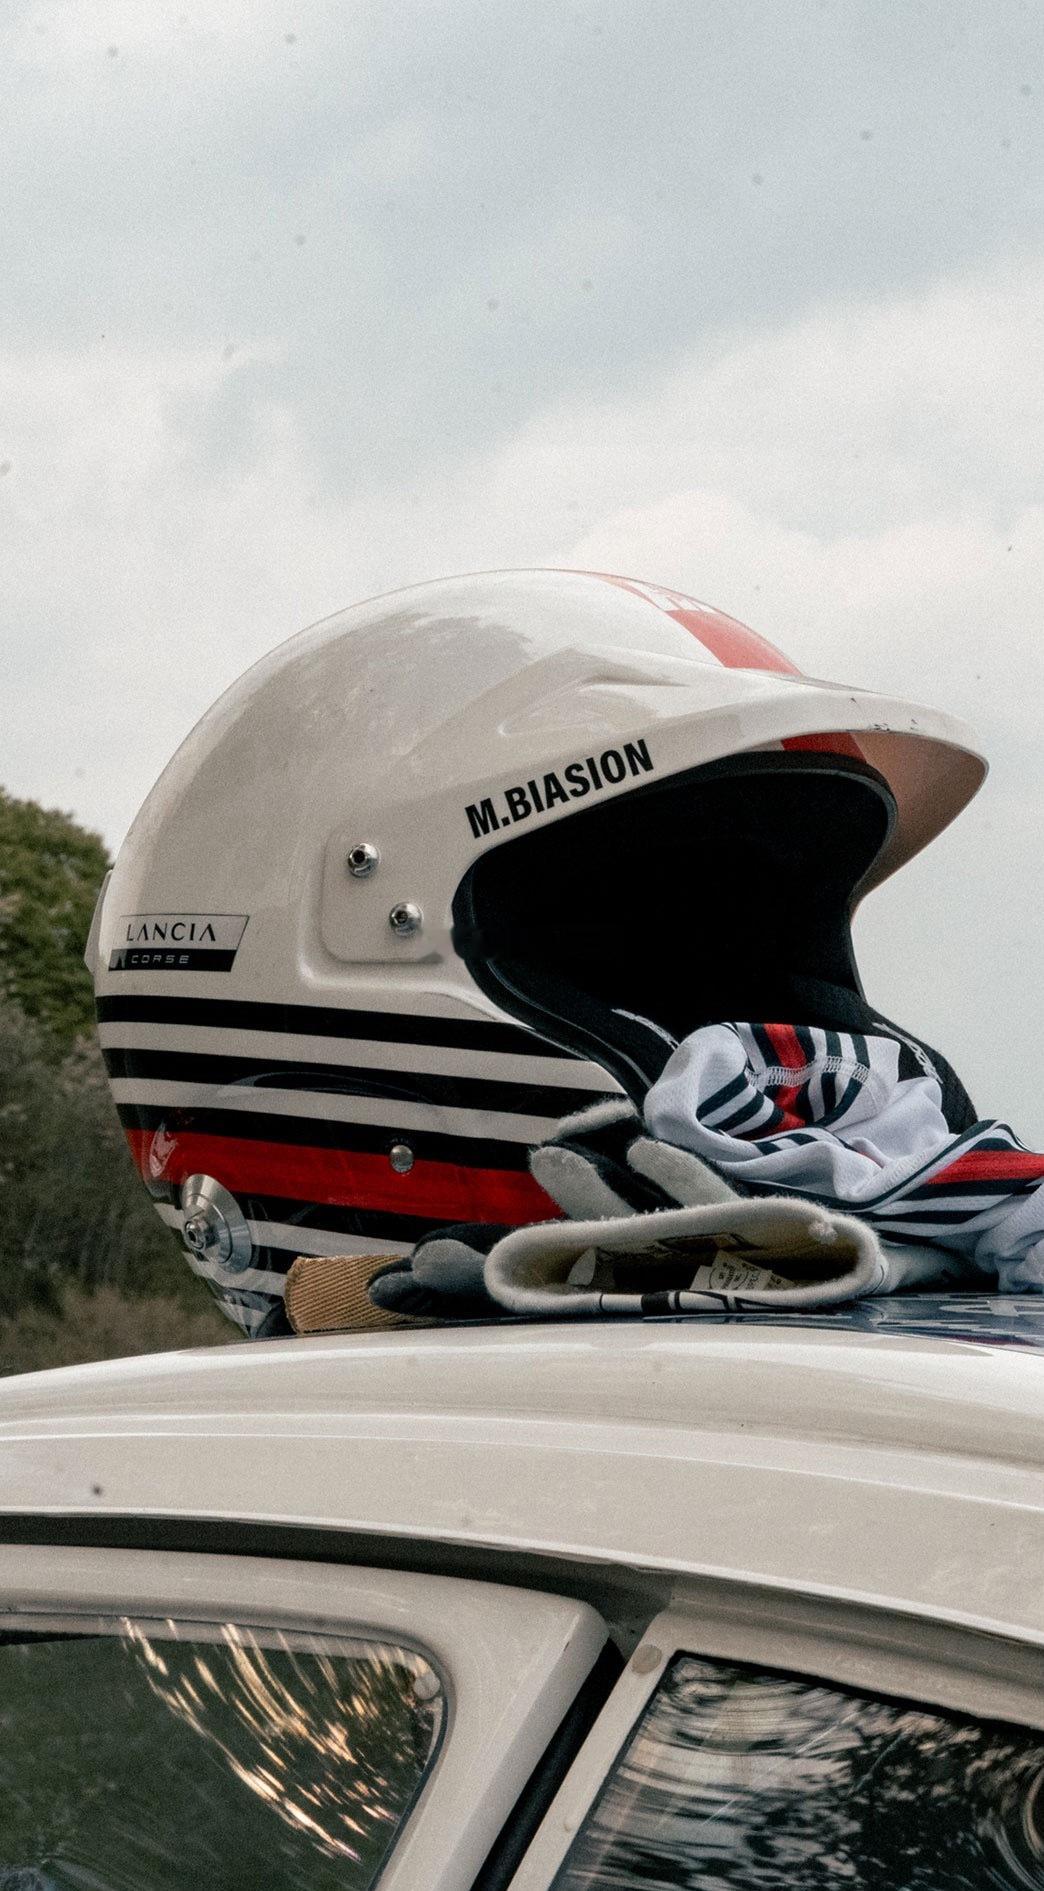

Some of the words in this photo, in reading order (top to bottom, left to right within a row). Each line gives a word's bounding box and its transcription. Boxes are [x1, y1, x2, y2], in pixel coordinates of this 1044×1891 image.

[465, 738, 654, 839] M.BIASION
[126, 922, 216, 942] LANCIA
[131, 954, 190, 964] CORSE
